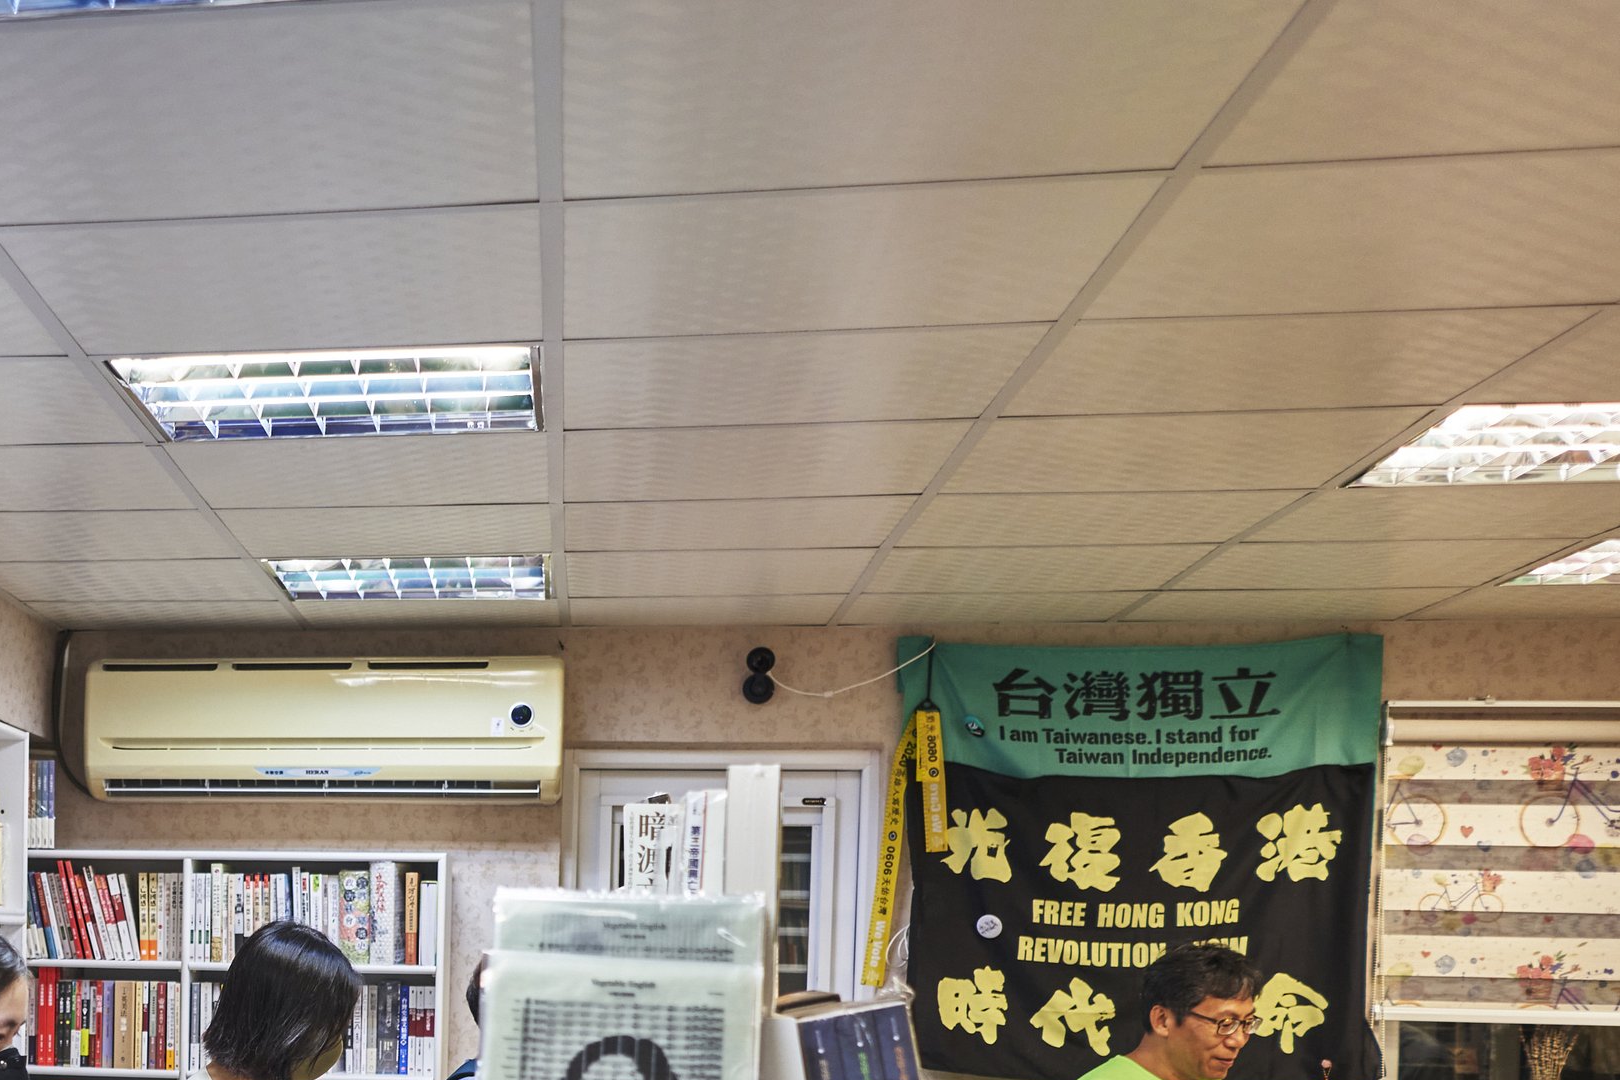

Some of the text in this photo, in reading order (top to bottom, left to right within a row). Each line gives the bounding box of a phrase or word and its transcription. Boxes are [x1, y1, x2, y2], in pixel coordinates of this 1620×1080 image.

[993, 667, 1281, 721] 台灣獨立
[1010, 729, 1038, 743] am
[1042, 727, 1153, 745] Taiwanese.
[1165, 725, 1223, 743] stand
[1230, 725, 1259, 742] for
[1055, 746, 1272, 767] Taiwan Independence.
[882, 845, 896, 877] 0606
[941, 803, 1342, 893] 光復香港
[1032, 898, 1240, 928] FREE HONG KONG
[1017, 936, 1167, 968] REVOLUTION
